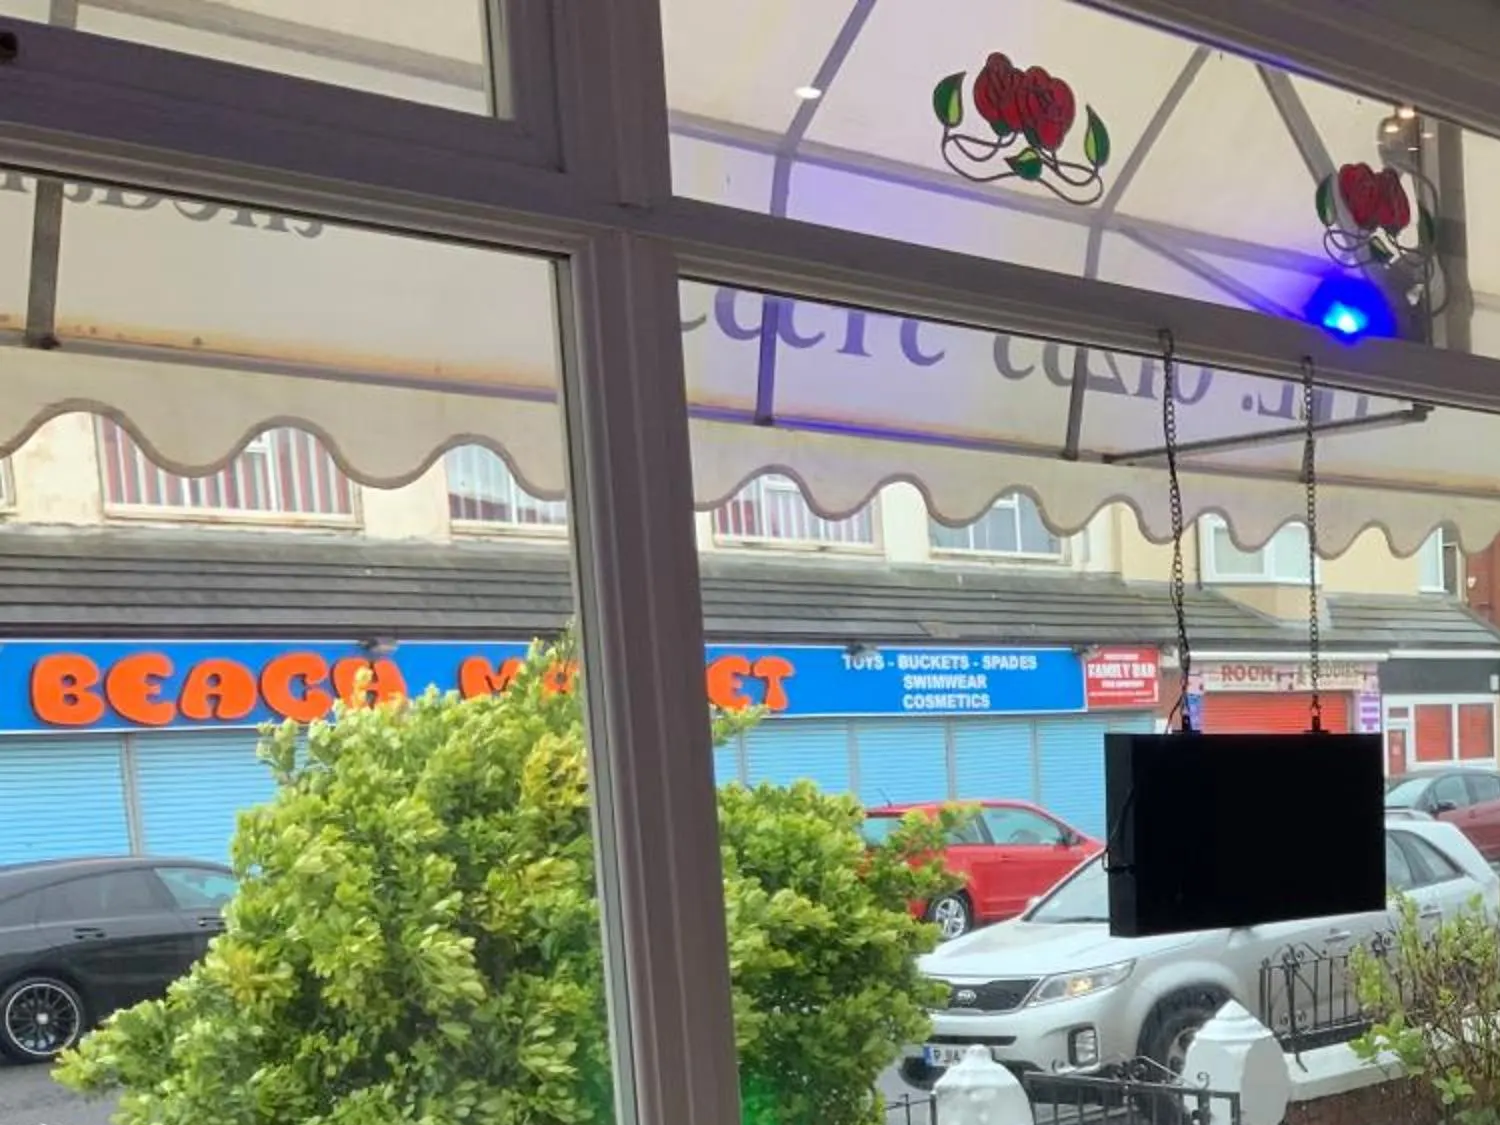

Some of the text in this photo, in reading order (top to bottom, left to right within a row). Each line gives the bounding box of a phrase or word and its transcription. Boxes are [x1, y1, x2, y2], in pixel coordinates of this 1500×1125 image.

[842, 653, 885, 671] TOYS
[897, 653, 970, 671] BUCKETS
[982, 653, 1038, 671] SPADES
[902, 673, 988, 690] SWIMWEAR
[902, 693, 991, 710] COSMETICS
